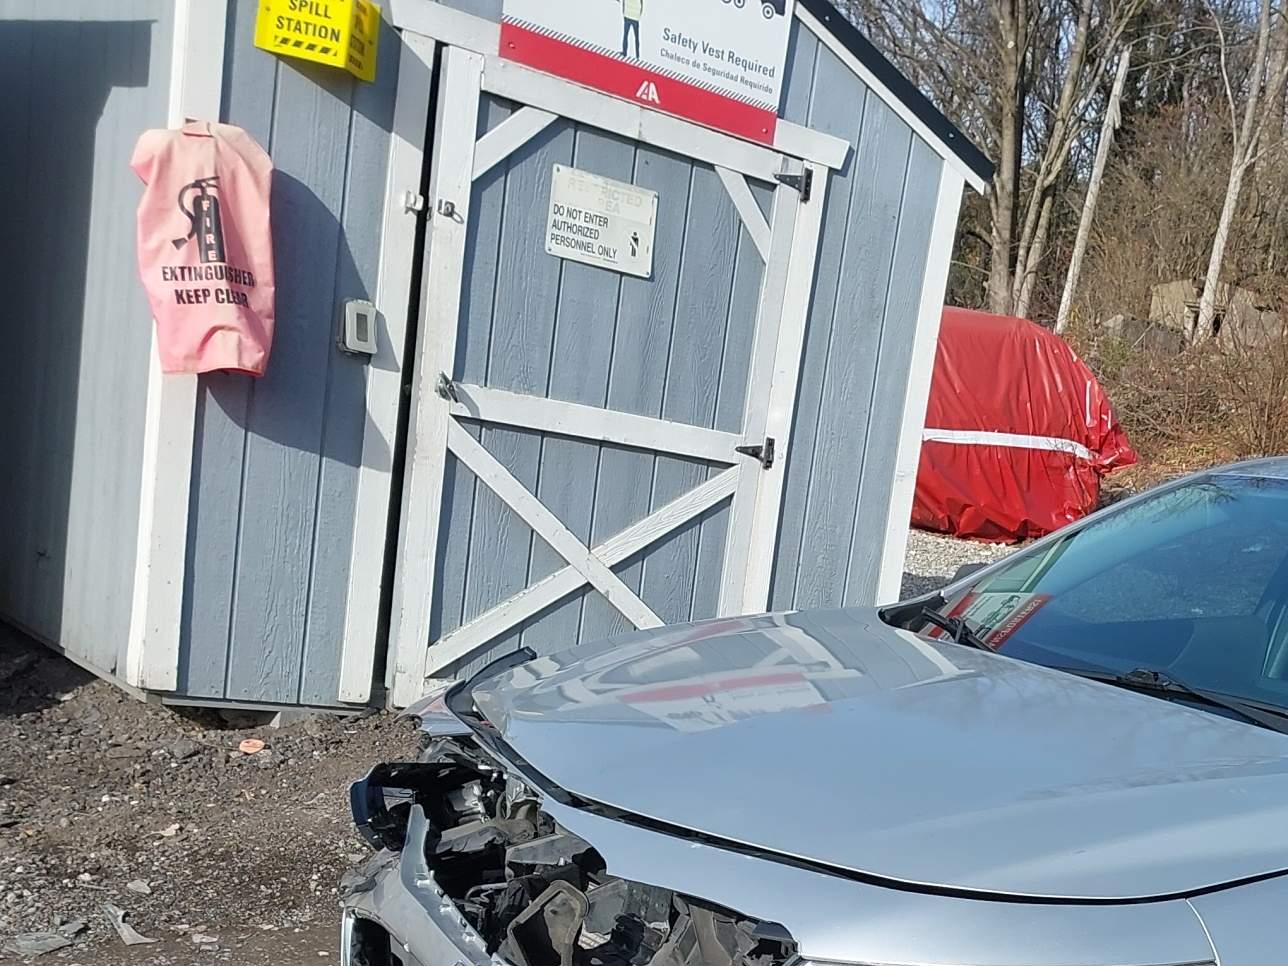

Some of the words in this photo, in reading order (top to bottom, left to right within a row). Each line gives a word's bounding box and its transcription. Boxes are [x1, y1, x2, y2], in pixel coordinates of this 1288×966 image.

[288, 0, 332, 19] SPILL
[276, 15, 341, 42] STATION
[662, 27, 699, 53] Safety
[702, 40, 725, 61] Vest
[727, 50, 776, 78] Required
[660, 48, 690, 66] Chaleco
[692, 59, 701, 69] de
[702, 63, 739, 82] Seguridad
[740, 76, 773, 94] Requirido
[567, 176, 642, 207] RERICTED
[553, 203, 565, 216] DO
[566, 207, 582, 220] NOT
[584, 210, 609, 228] ENTER
[201, 200, 217, 261] FIRE
[551, 218, 600, 240] AUTHORIZED
[550, 233, 596, 254] PERSONNEL
[597, 245, 618, 259] ONLY
[161, 265, 255, 288] EXTINGUISHER
[174, 288, 211, 304] KEEP
